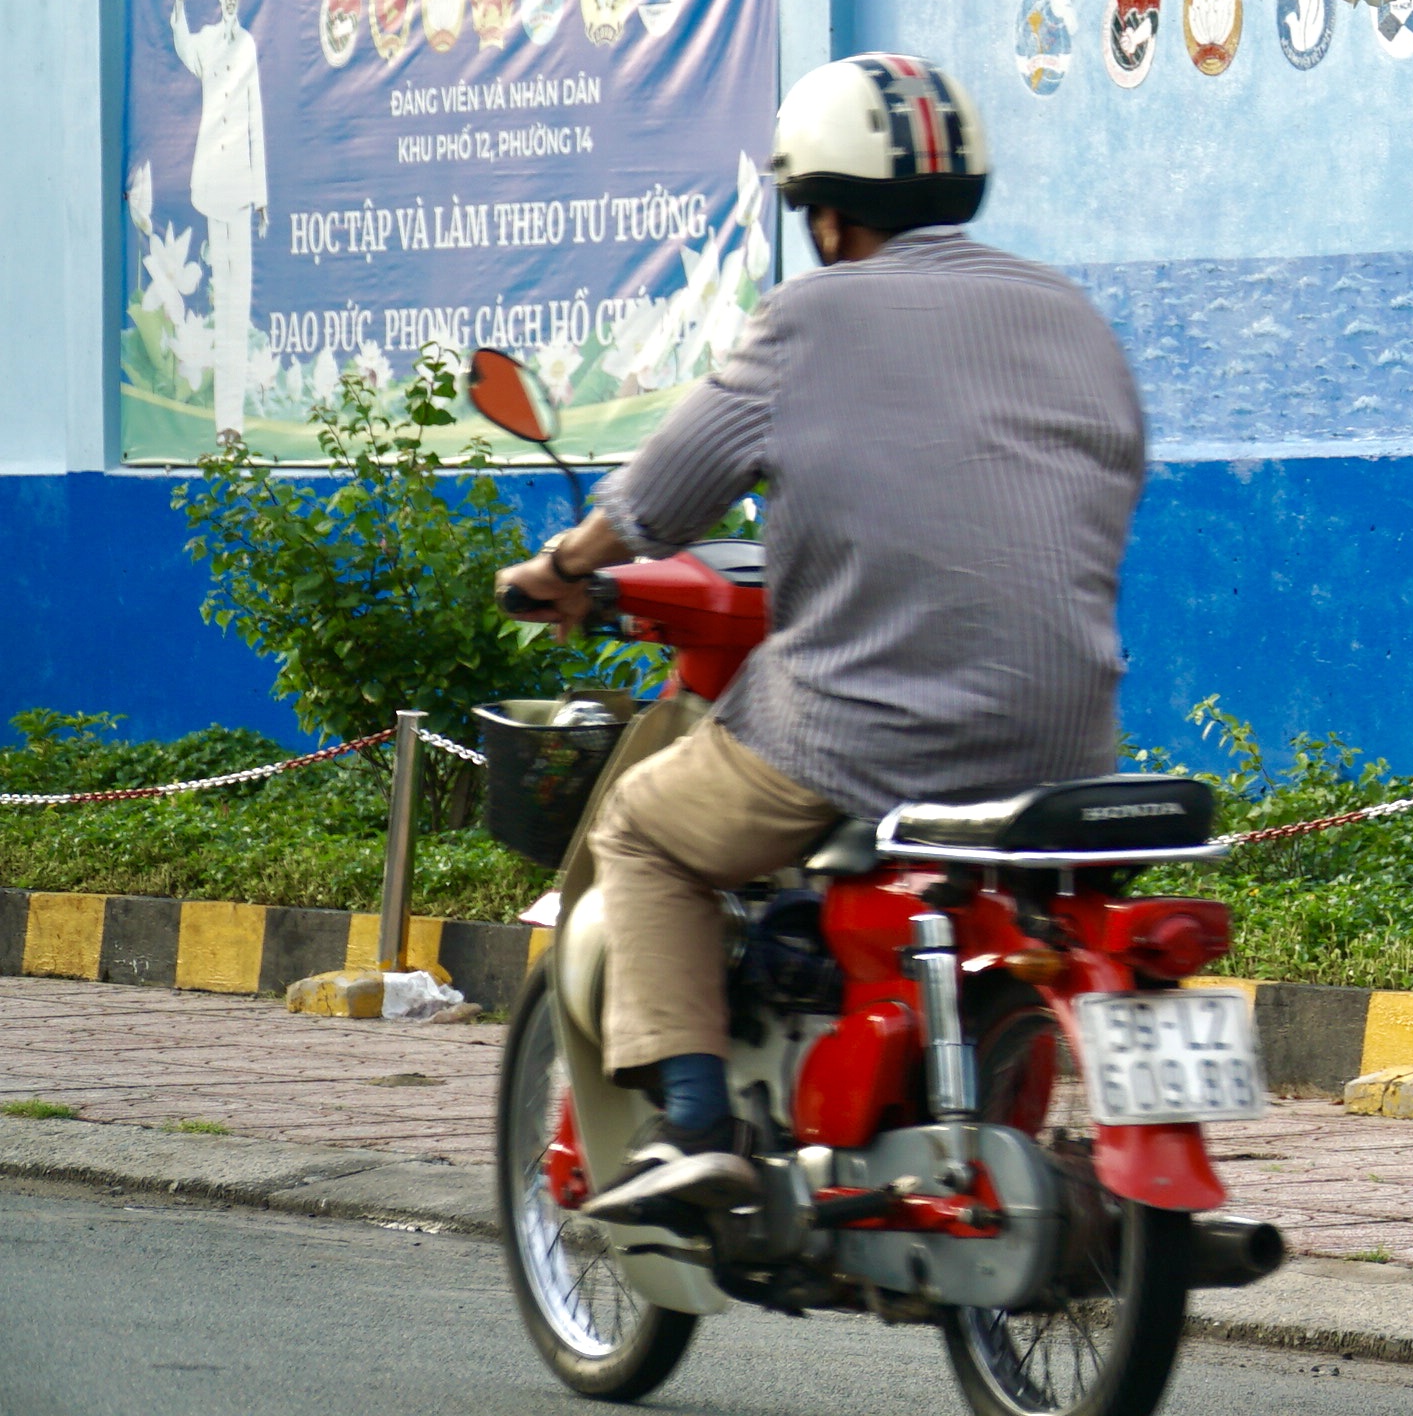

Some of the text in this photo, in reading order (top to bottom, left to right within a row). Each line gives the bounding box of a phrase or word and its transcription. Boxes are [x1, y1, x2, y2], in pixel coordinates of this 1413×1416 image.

[390, 71, 601, 116] ĐẢNG VIÊN VÀ NHÂN DÂN
[398, 122, 594, 163] KHU PHỐ 12, PHƯỜNG 14
[290, 211, 341, 265] HỌC
[344, 197, 393, 264] TẬP
[395, 195, 430, 251] VÀ
[433, 193, 490, 249] LÀM
[493, 200, 565, 246] THEO
[569, 192, 610, 244] TƯ
[384, 306, 471, 351] PHONG
[474, 293, 544, 349] CÁCH
[548, 286, 590, 347] HỒ
[1081, 802, 1187, 821] HONDA
